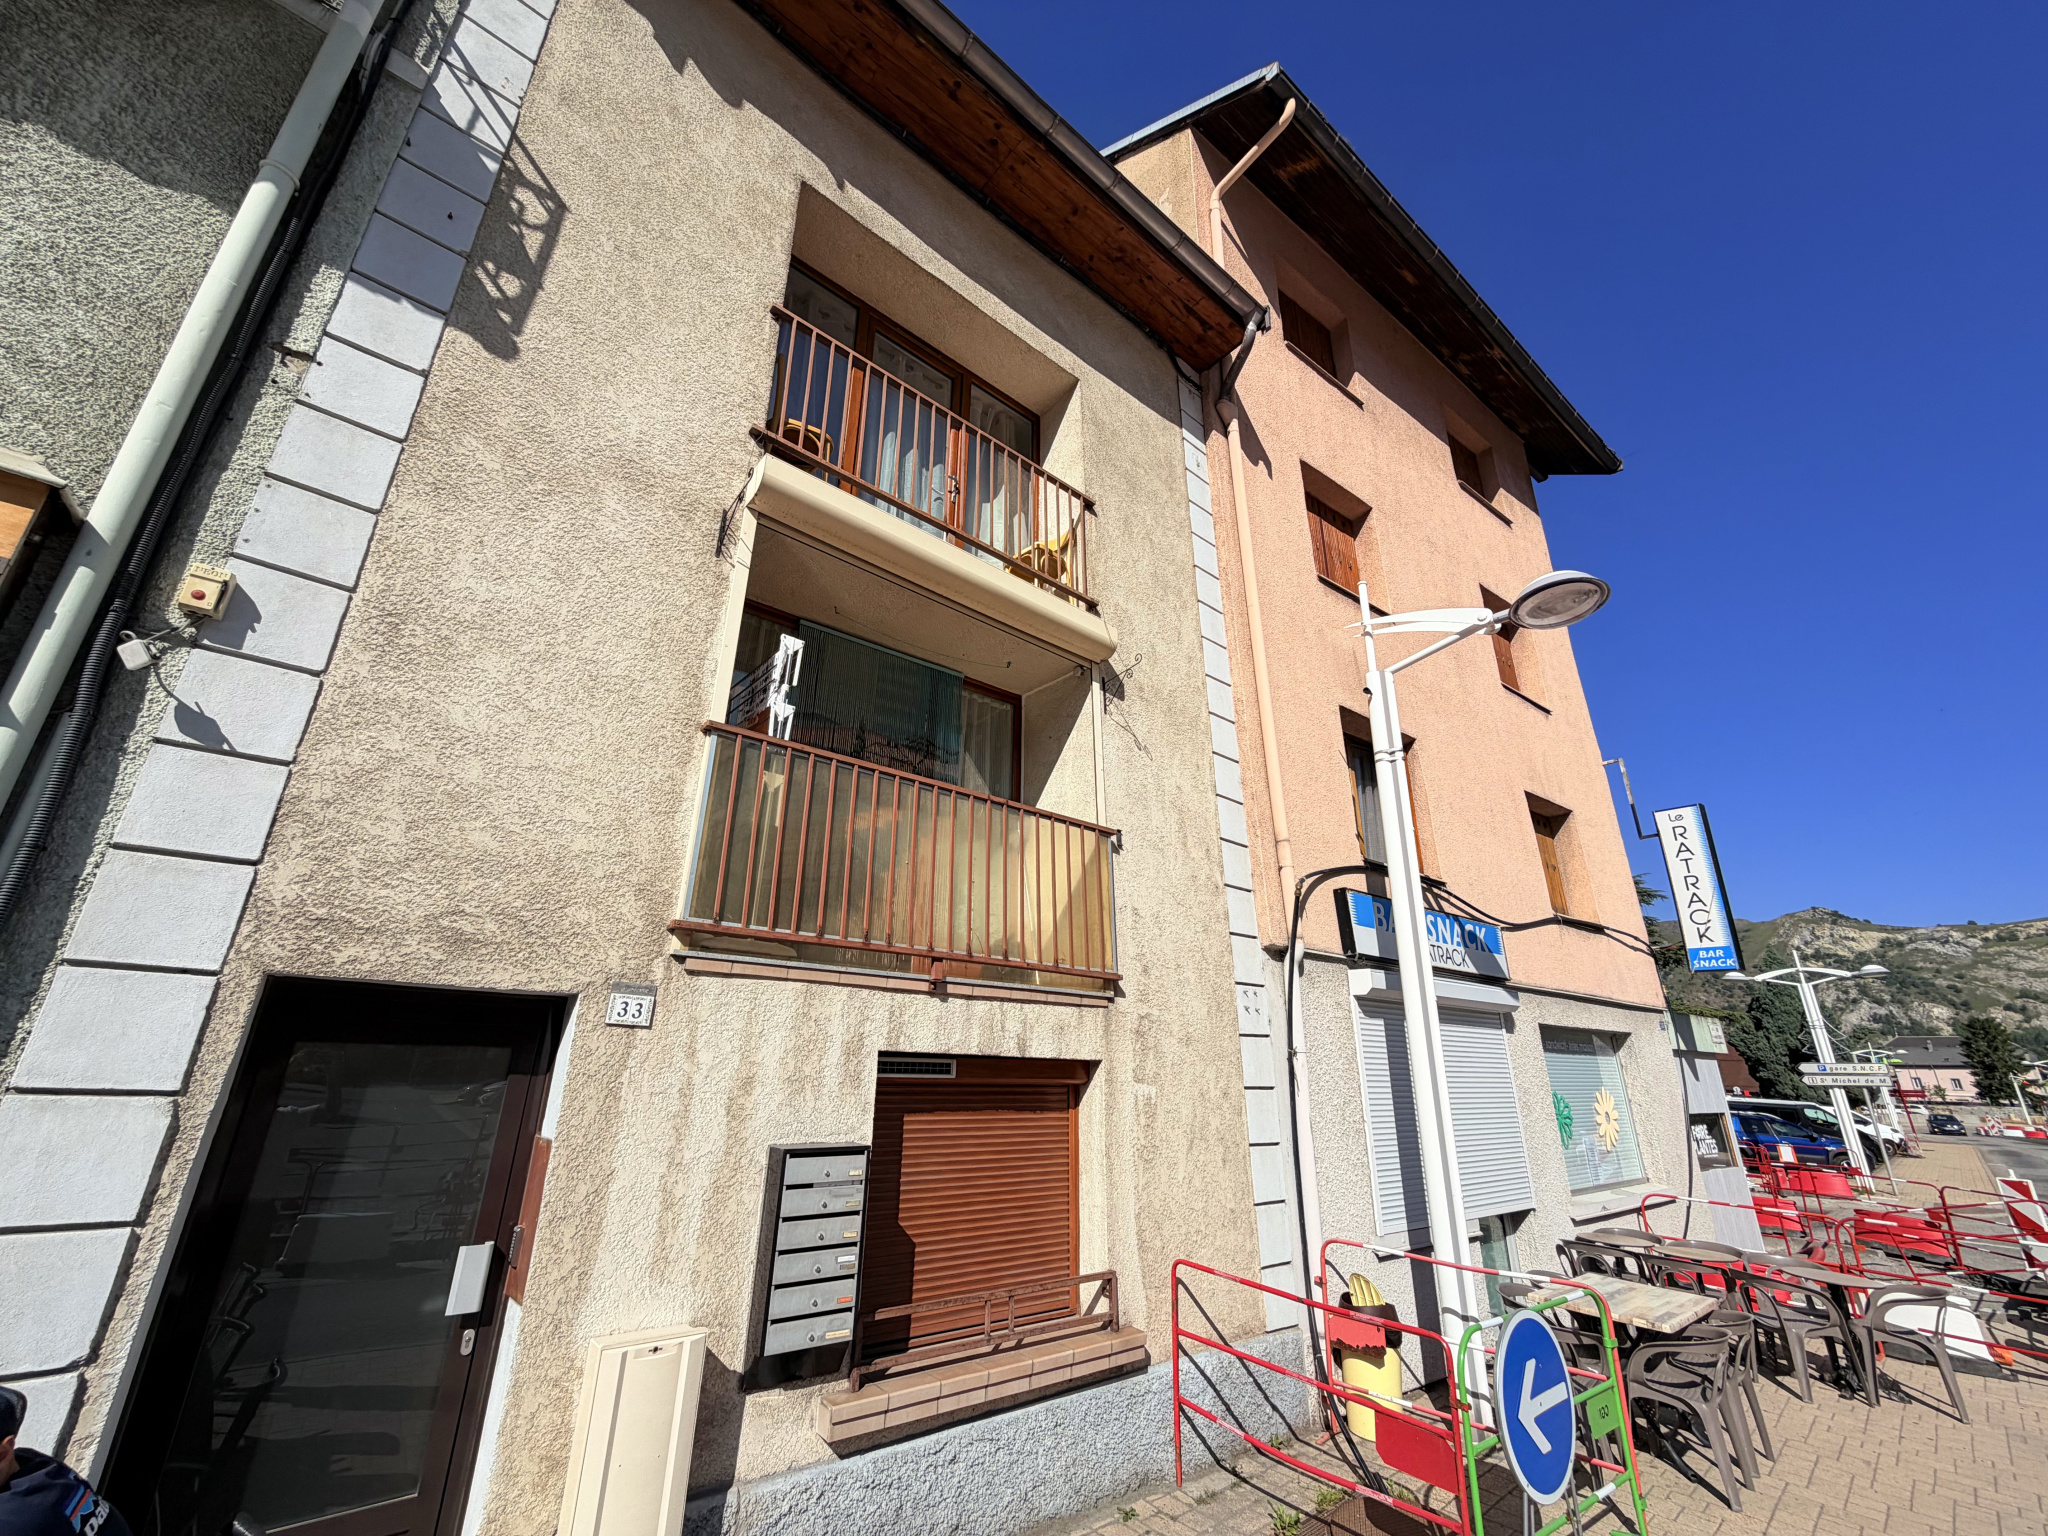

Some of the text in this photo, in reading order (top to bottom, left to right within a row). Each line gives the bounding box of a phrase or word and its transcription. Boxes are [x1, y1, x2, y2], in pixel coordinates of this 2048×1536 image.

[1667, 813, 1684, 822] Le
[1671, 825, 1715, 943] RATRACK
[1373, 901, 1491, 954] BA SNACK
[1699, 949, 1725, 958] BAR
[1693, 958, 1736, 968] SNACK
[616, 1001, 644, 1019] 33
